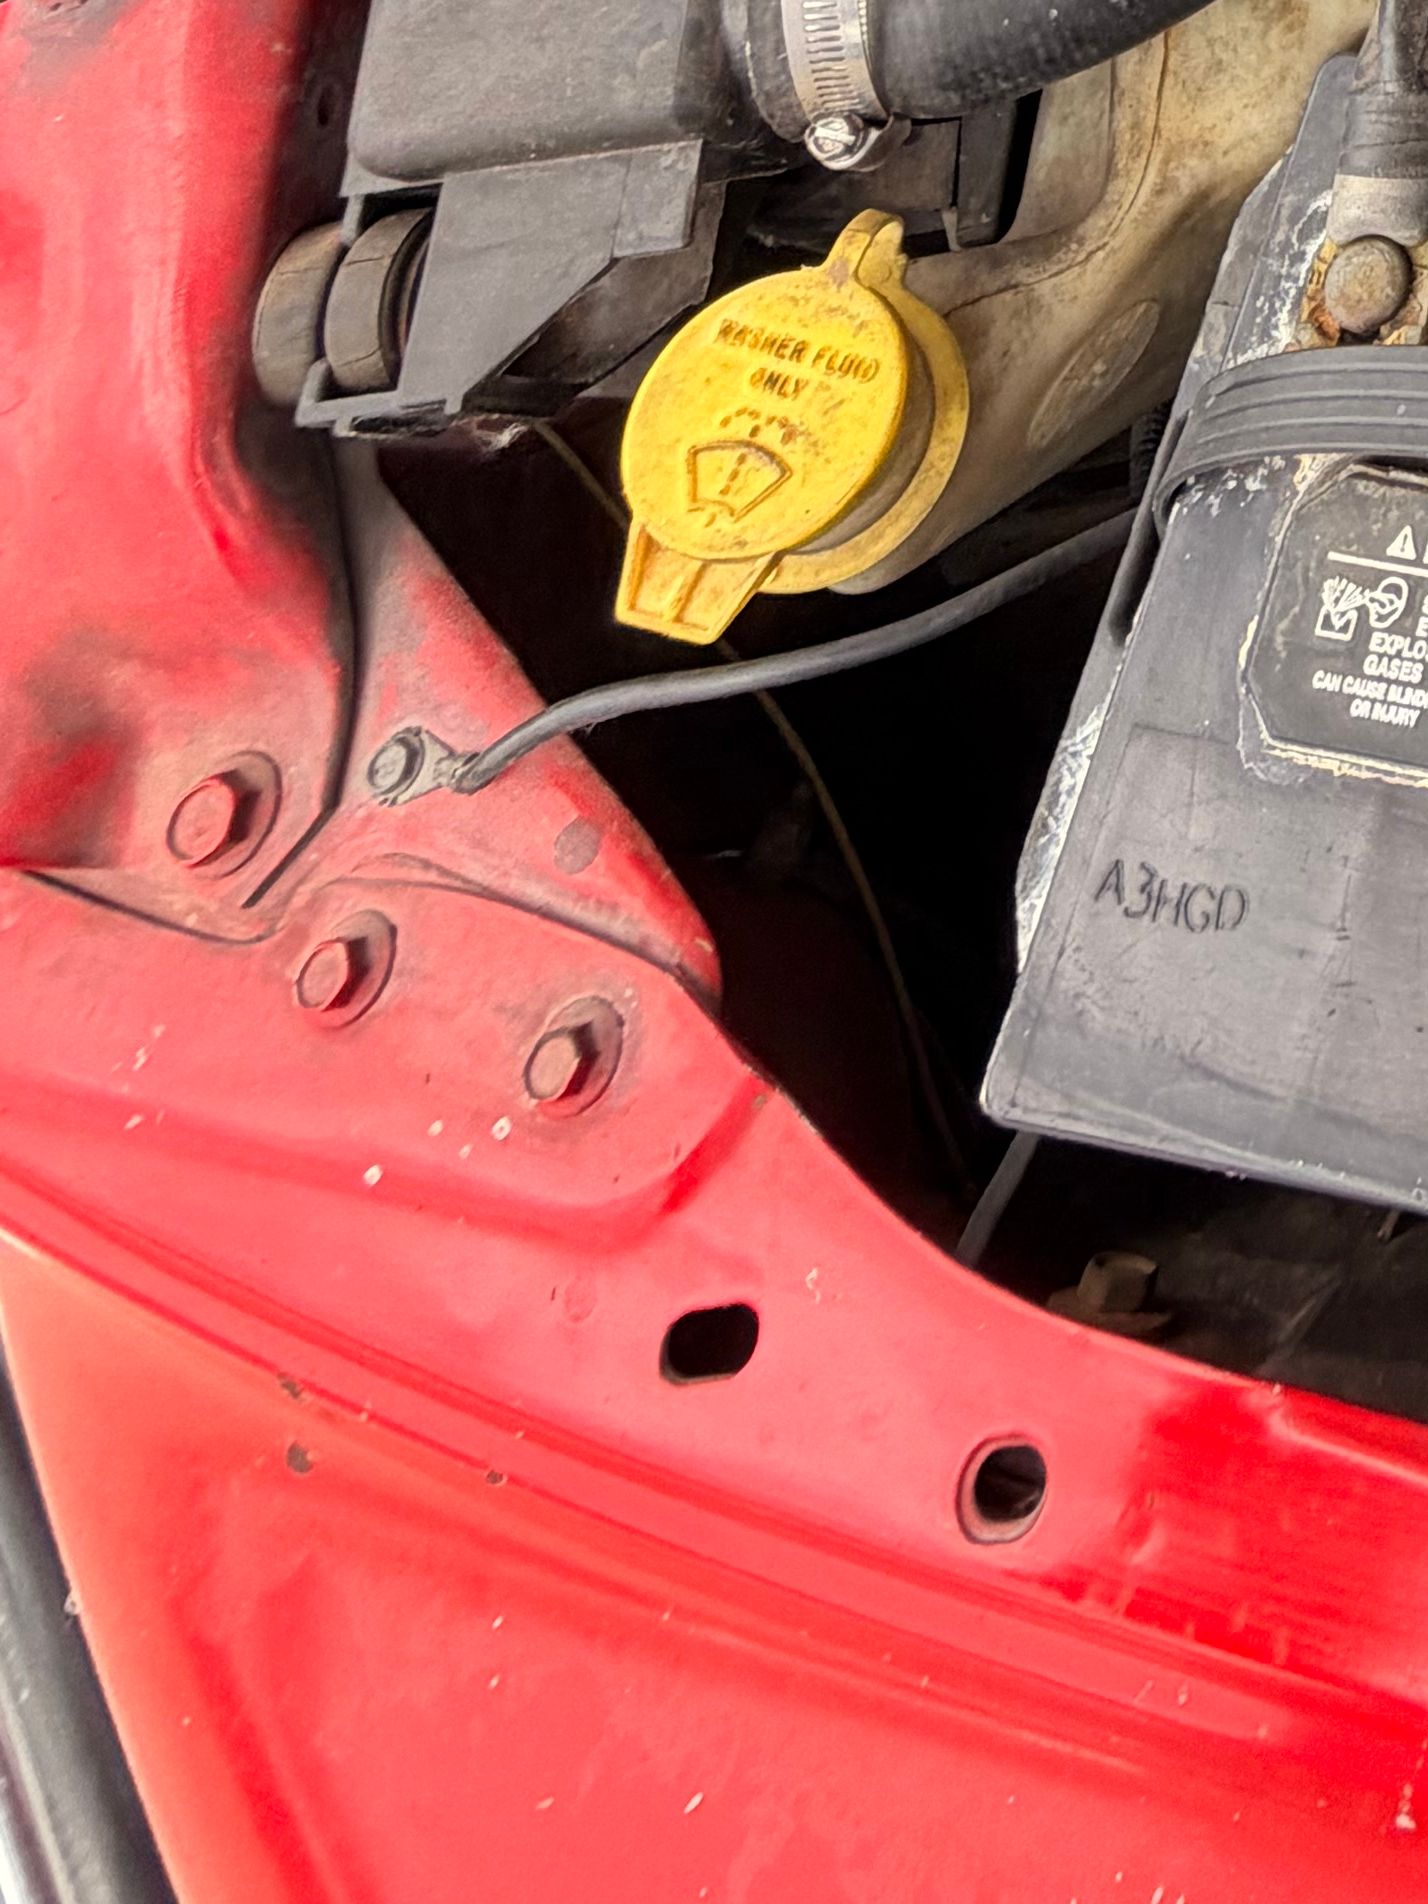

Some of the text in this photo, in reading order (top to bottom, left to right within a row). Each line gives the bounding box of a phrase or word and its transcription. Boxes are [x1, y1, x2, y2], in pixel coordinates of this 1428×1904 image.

[714, 318, 880, 384] WASHER FLUID
[749, 367, 808, 400] ONLY
[1363, 655, 1424, 684] GASES
[1311, 670, 1342, 692] CAN
[1342, 676, 1387, 700] CAUSE
[1350, 698, 1371, 718] OR
